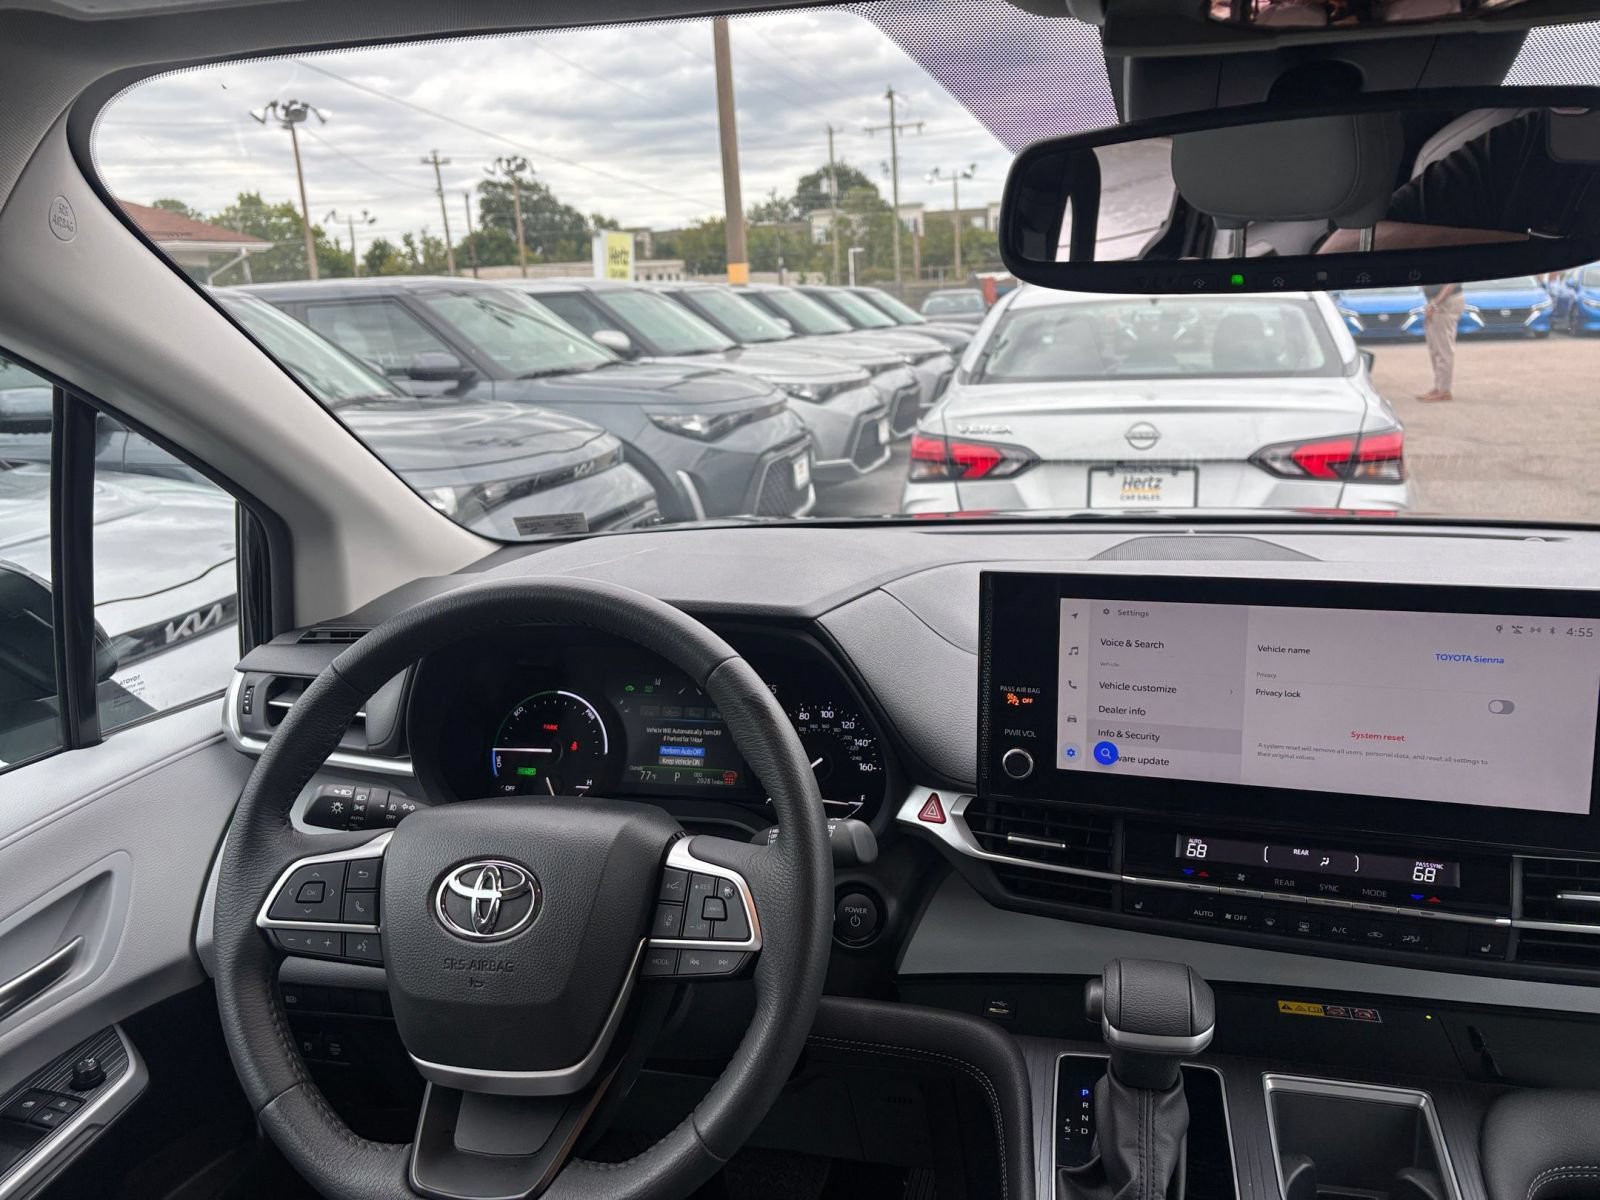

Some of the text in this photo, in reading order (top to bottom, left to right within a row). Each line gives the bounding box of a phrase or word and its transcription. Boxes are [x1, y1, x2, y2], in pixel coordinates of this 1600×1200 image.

[1122, 475, 1163, 490] Hertz
[1117, 609, 1150, 618] Settings
[1566, 627, 1593, 638] 4:55
[1100, 638, 1165, 649] Voice & Search
[1257, 645, 1287, 653] Vehicle
[1435, 653, 1505, 664] TOYOTA Sienna
[1256, 671, 1277, 679] Privacy
[1099, 681, 1177, 694] Vehicle customize
[1256, 688, 1302, 698] Privacy lock
[513, 706, 525, 717] ECO
[585, 708, 597, 721] PWR
[820, 710, 835, 718] 100
[1098, 705, 1147, 716] Dealer info
[799, 712, 810, 720] 80
[841, 721, 855, 729] 120
[672, 729, 702, 737] Automatically
[1004, 728, 1037, 738] PWR VOL
[1098, 729, 1161, 742] Info & Security
[1351, 730, 1382, 740] System
[854, 739, 868, 747] 140
[661, 746, 680, 755] Perform
[680, 748, 692, 756] Auto
[1365, 751, 1394, 759] personal
[662, 757, 674, 765] Keep
[675, 758, 692, 766] Vehicle
[1137, 757, 1170, 766] update
[859, 763, 873, 771] 160
[674, 771, 681, 782] P
[1186, 843, 1208, 858] 68
[1293, 848, 1310, 856] REAR
[1412, 866, 1436, 883] 68
[1274, 878, 1295, 887] REAR
[1319, 884, 1340, 893] SYNC
[1362, 888, 1387, 898] MODE
[844, 905, 868, 914] POWER
[1193, 909, 1214, 918] AUTO
[1331, 926, 1347, 934] A/C
[443, 958, 514, 973] SRS AIRBAG
[1082, 1101, 1089, 1109] R
[1081, 1114, 1089, 1122] N
[1080, 1127, 1089, 1135] D
